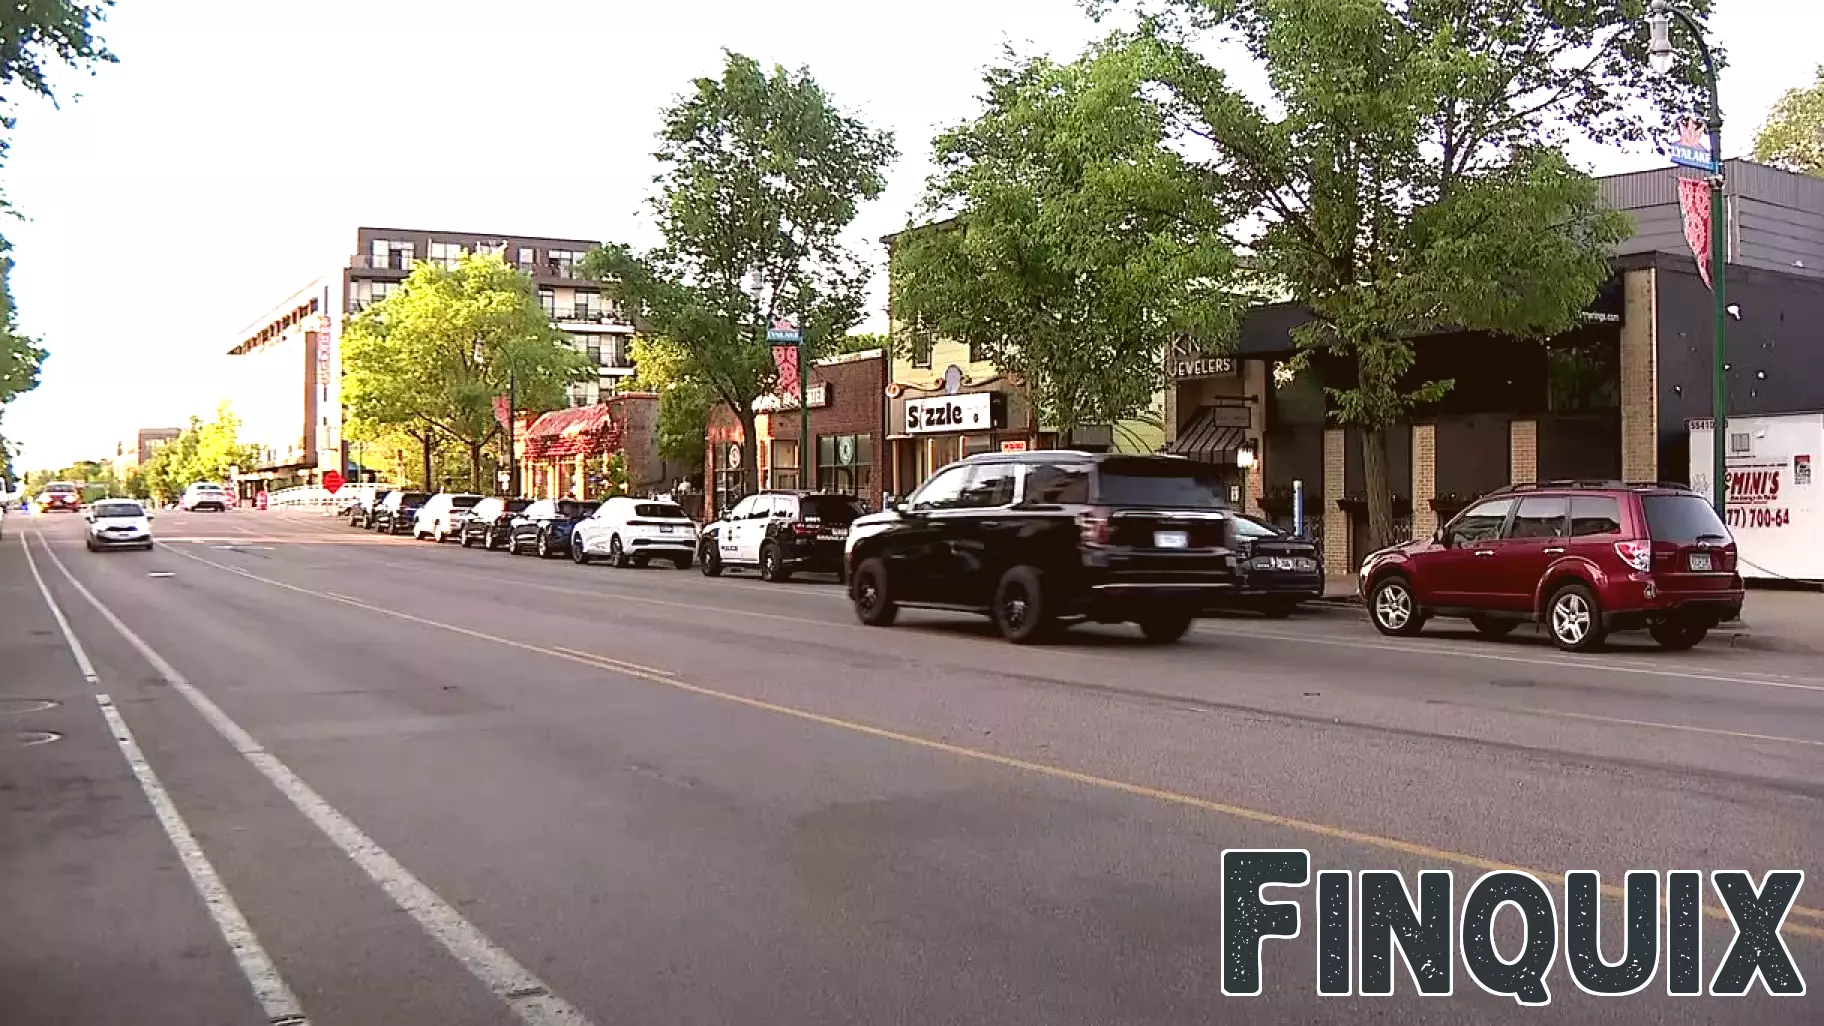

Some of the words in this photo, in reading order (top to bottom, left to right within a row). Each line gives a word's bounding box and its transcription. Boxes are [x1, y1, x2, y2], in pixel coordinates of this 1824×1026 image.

[908, 402, 963, 429] Sizzle
[1730, 471, 1780, 495] MINI'S
[1726, 507, 1747, 528] 77)
